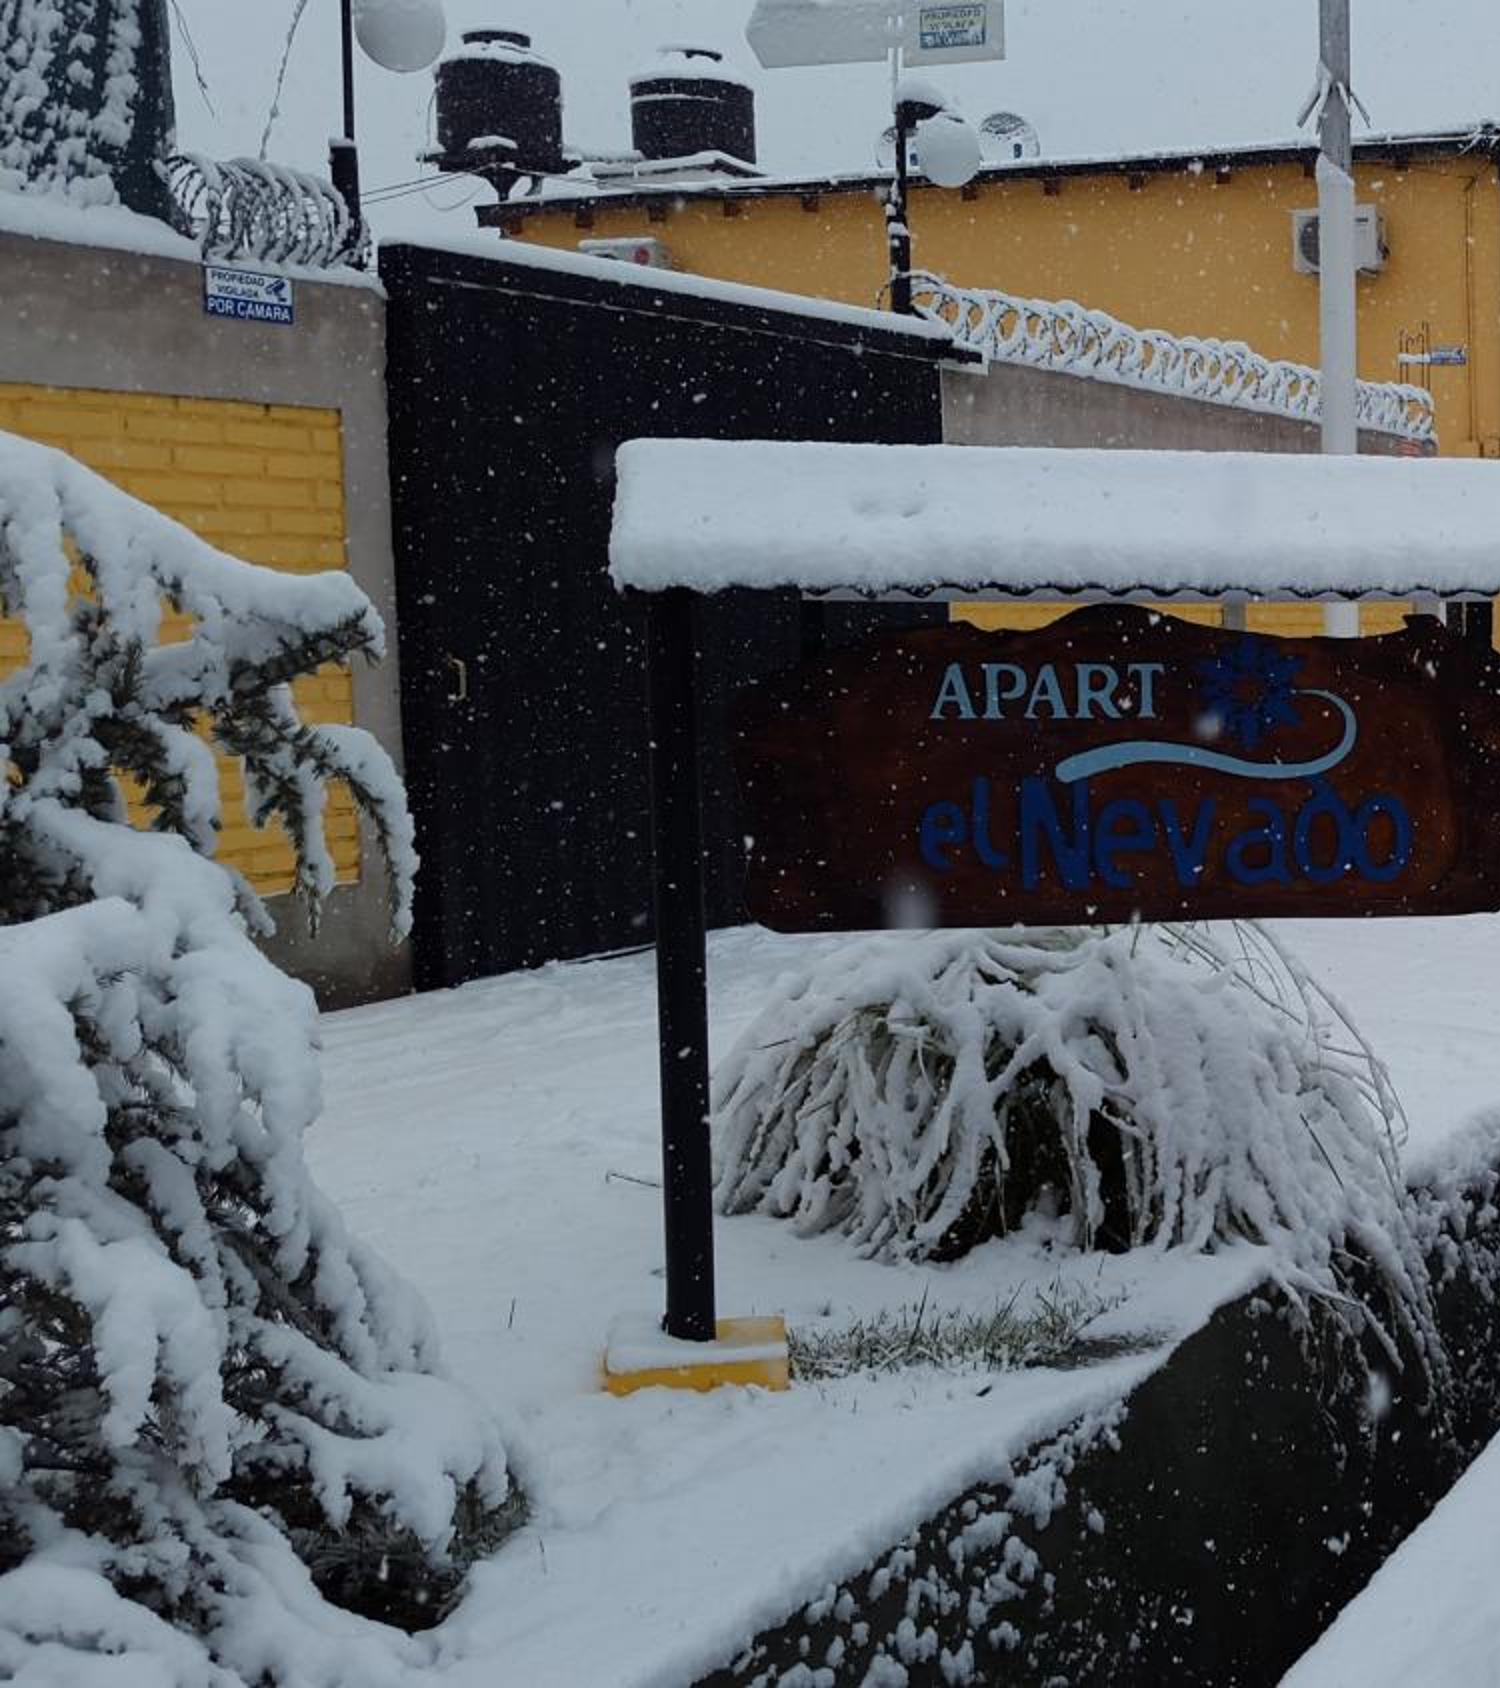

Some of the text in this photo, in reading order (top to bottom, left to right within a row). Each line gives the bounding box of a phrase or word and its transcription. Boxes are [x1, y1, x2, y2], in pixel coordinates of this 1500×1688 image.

[212, 272, 265, 287] PROPIEDAD
[216, 286, 258, 297] VIGILADA
[207, 298, 290, 321] POR CAMARA
[929, 662, 1165, 720] APART
[919, 772, 1414, 894] el Nevado
